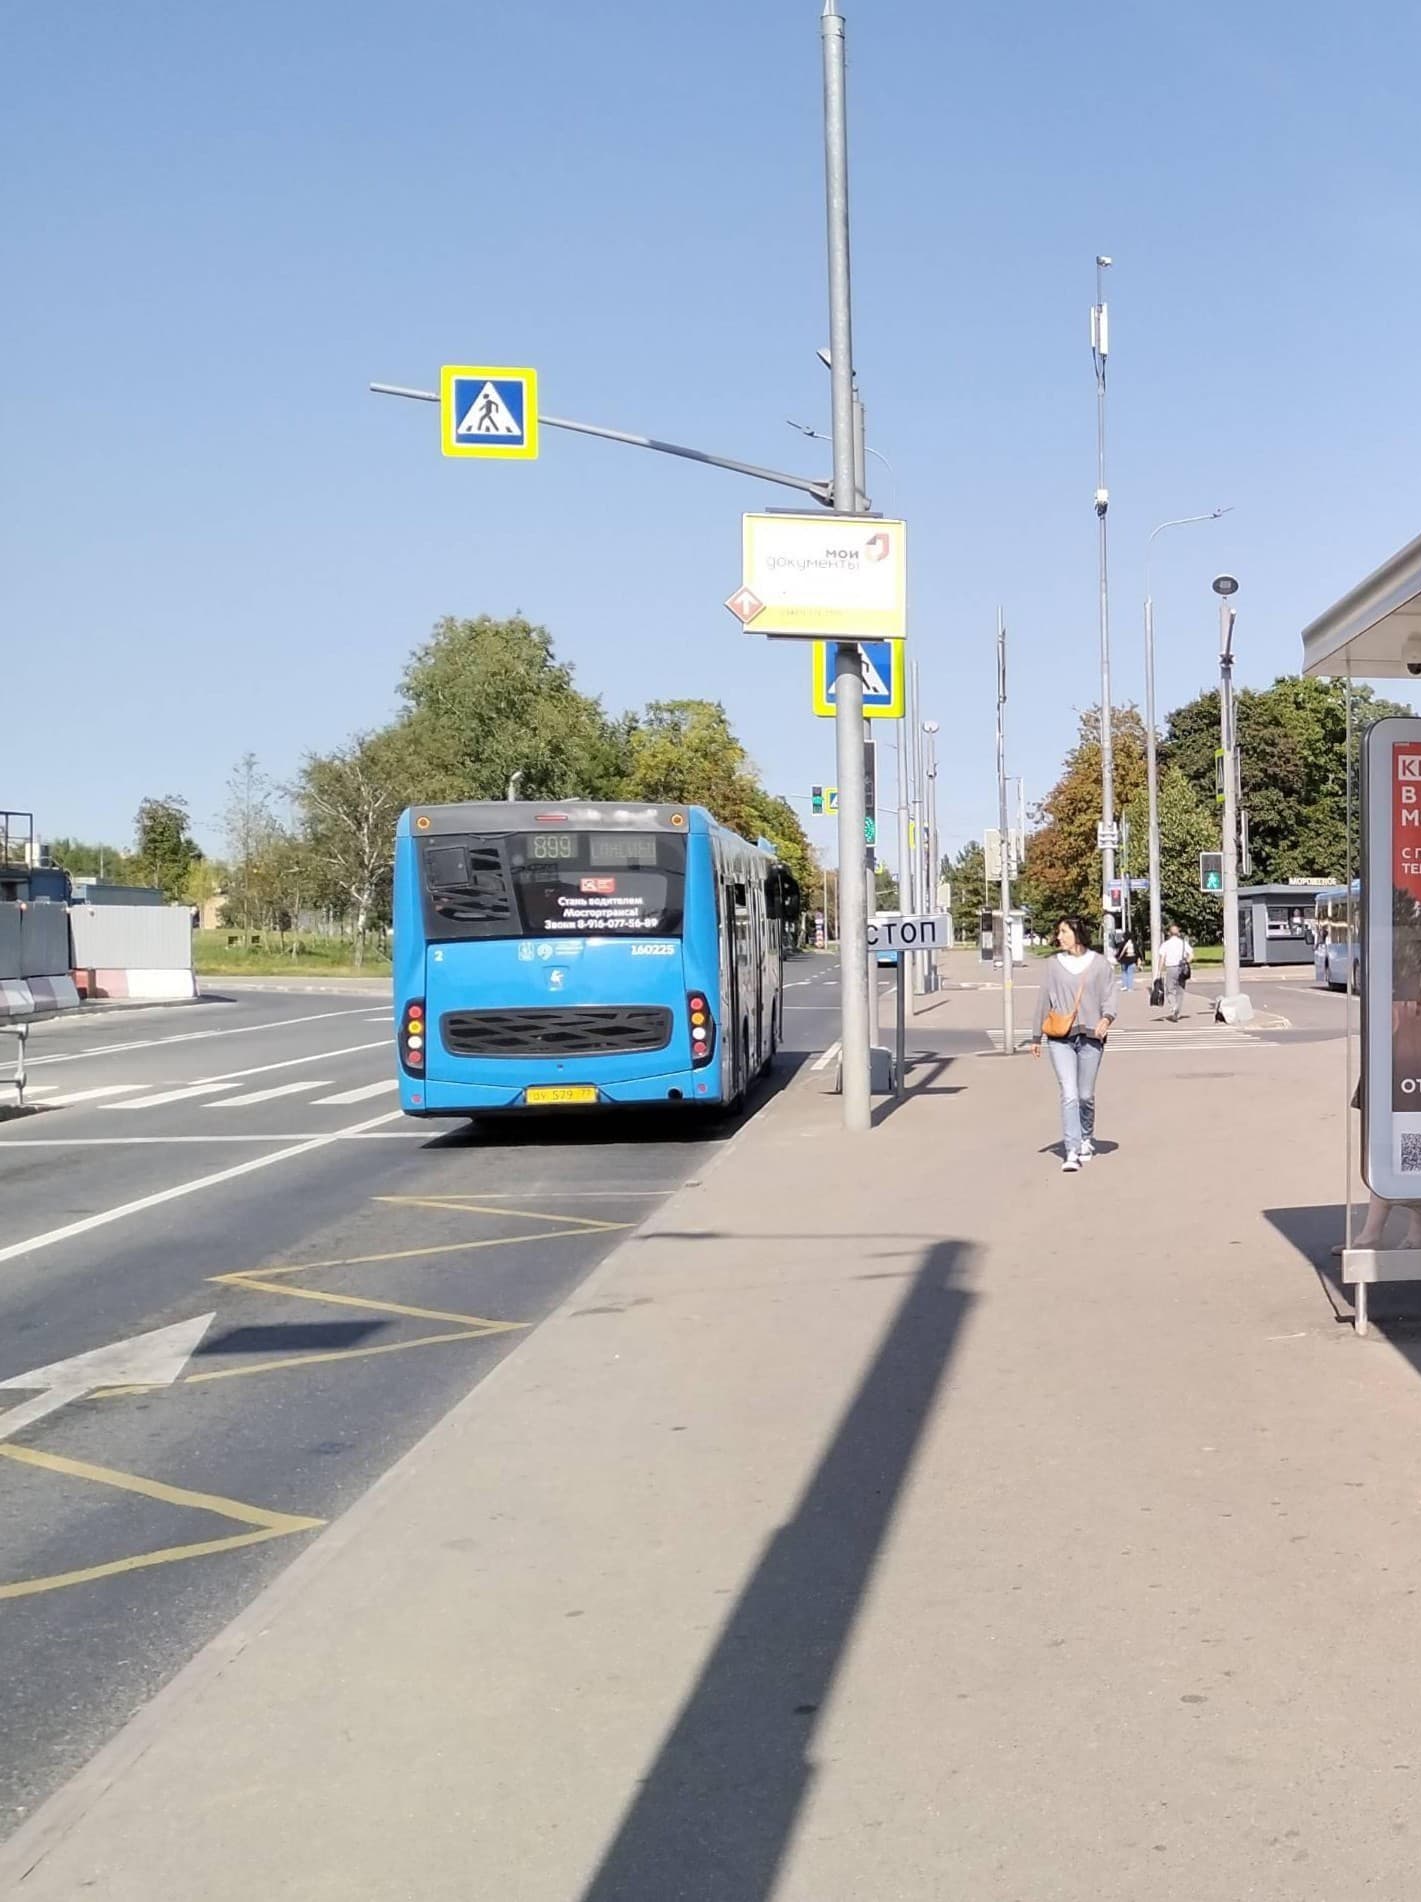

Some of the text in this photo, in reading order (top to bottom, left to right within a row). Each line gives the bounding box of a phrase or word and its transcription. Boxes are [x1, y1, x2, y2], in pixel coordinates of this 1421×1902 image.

[1401, 786, 1417, 804] В
[534, 835, 571, 858] 899
[1401, 847, 1412, 860] С
[557, 896, 644, 907] Стань водителем
[544, 920, 576, 930] Звони
[867, 921, 936, 945] СТОП
[434, 950, 444, 961] 2
